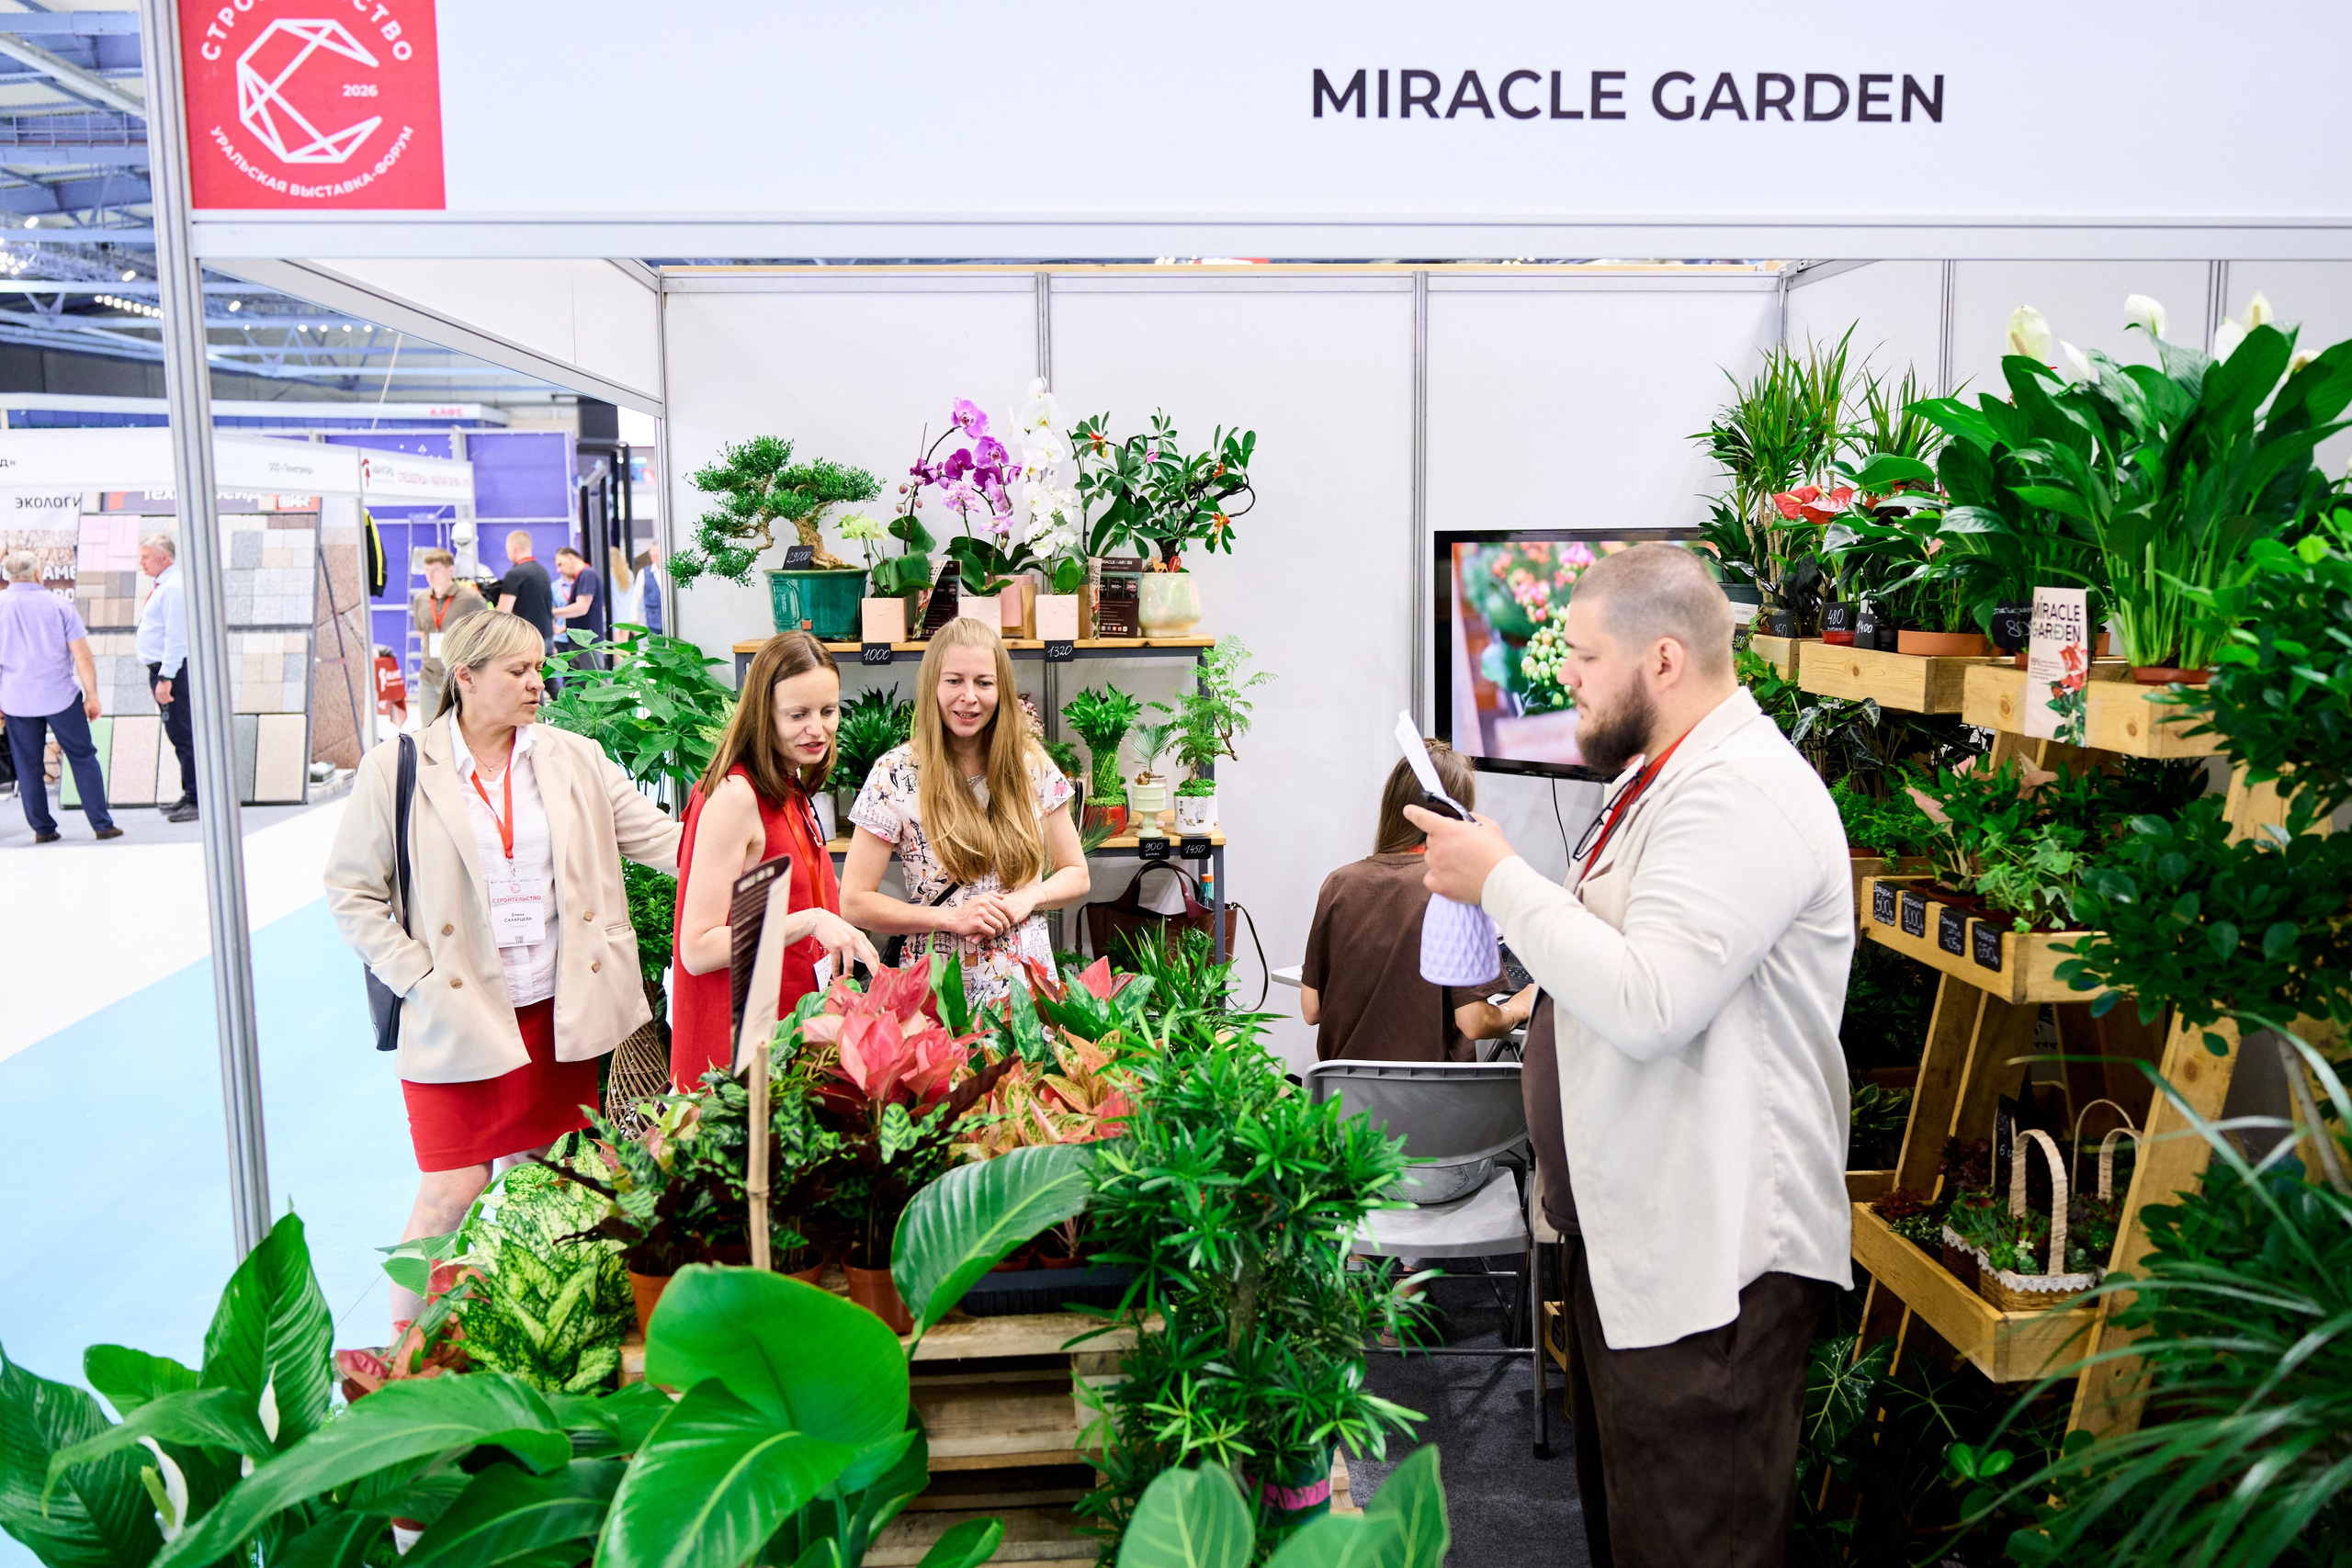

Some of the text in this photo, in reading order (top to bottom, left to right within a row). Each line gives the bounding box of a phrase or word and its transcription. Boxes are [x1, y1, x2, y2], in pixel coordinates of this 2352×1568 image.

[342, 84, 379, 97] 2026
[1311, 68, 1945, 124] MIRACLE GARDEN
[210, 125, 414, 198] УРАЛЬСКАЯ ВЫСТАВКА-ФОРУМ
[786, 550, 811, 563] 29000
[1827, 608, 1844, 626] 480
[1856, 619, 1873, 634] 1400
[864, 649, 891, 661] 1000
[1047, 645, 1073, 658] 1320
[1145, 841, 1164, 852] 900
[1184, 844, 1206, 854] 1450
[492, 895, 542, 904] СТРОИТЕЛЬСТВО
